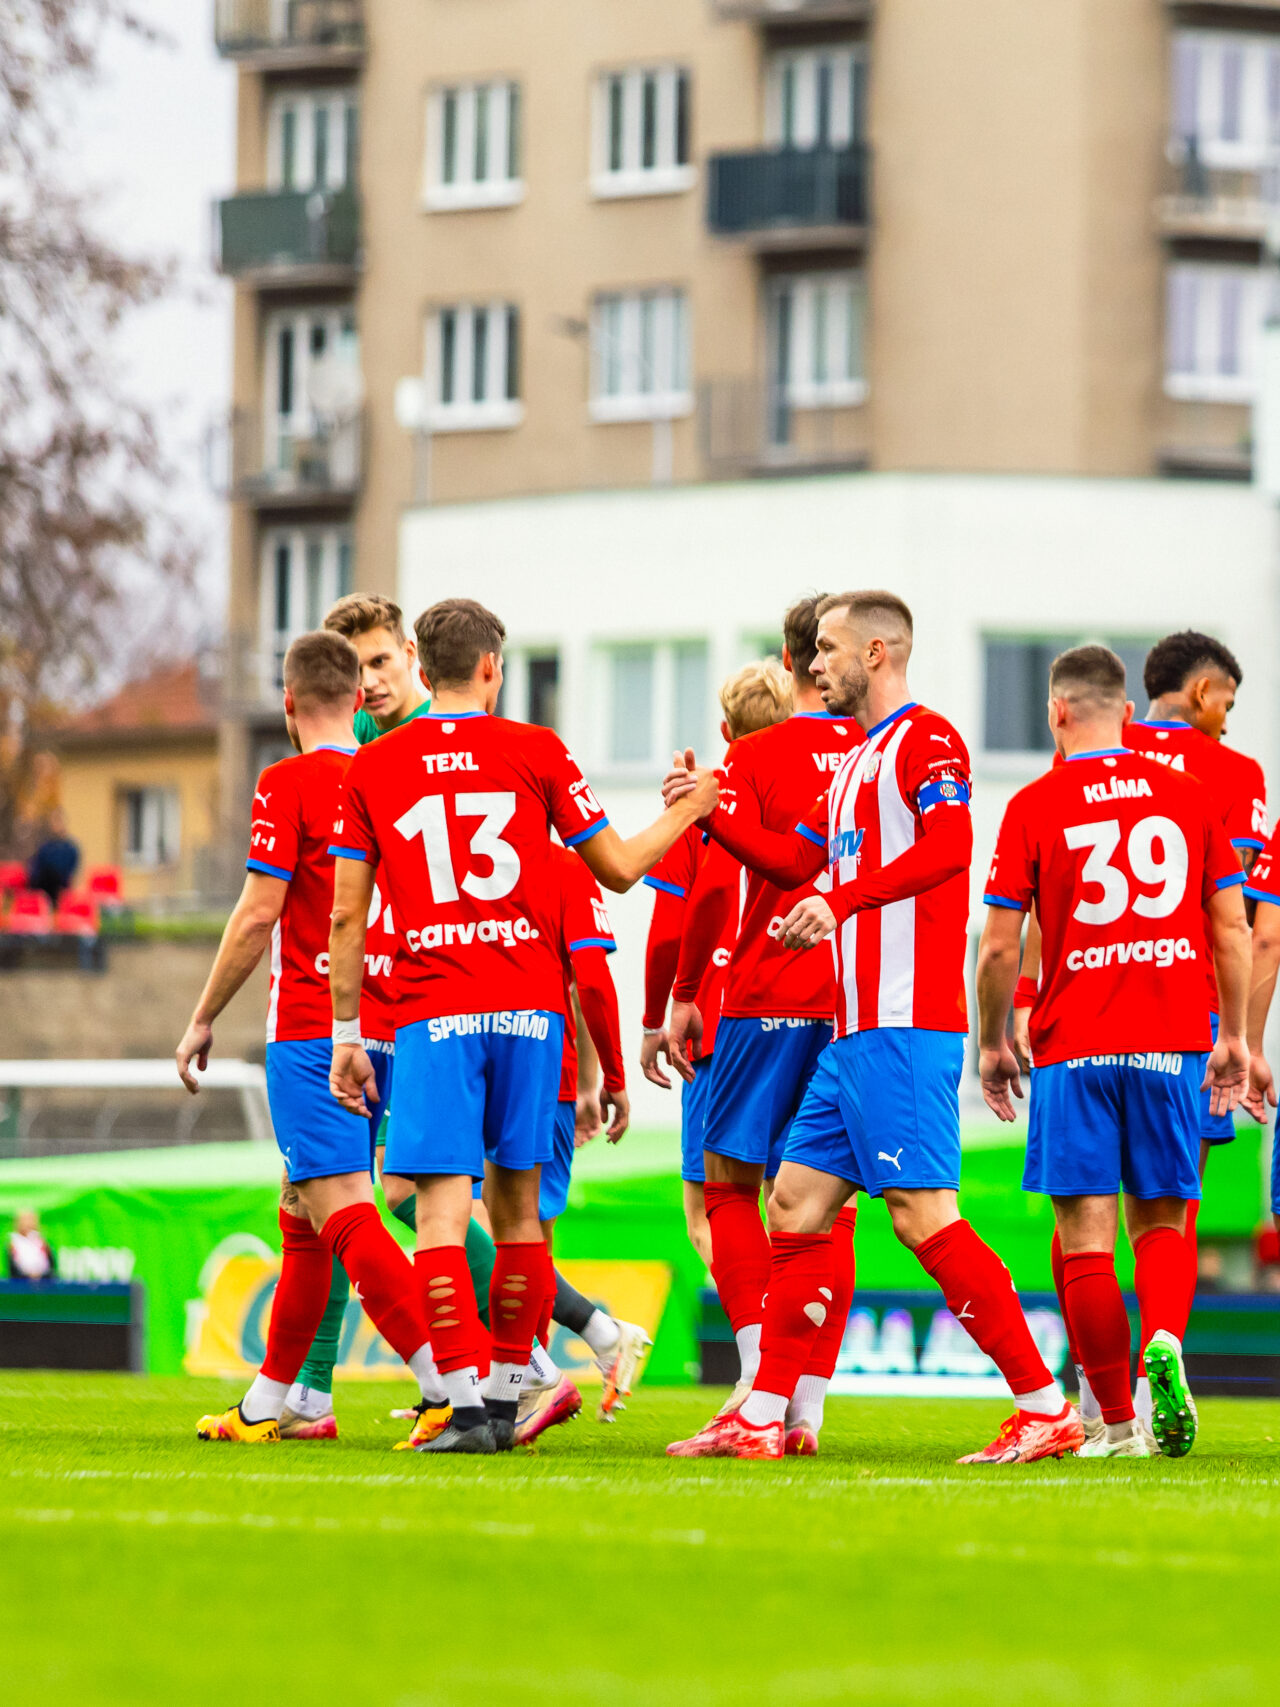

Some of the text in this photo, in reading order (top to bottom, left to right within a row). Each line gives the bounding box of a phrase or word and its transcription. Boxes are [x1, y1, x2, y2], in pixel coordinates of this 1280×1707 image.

[422, 751, 479, 774] TEXL
[1083, 778, 1153, 803] KLÍMA
[393, 791, 521, 904] 13
[1064, 815, 1189, 926] 39
[1066, 937, 1197, 971] carvago.
[427, 1011, 550, 1042] SPORTISIMO
